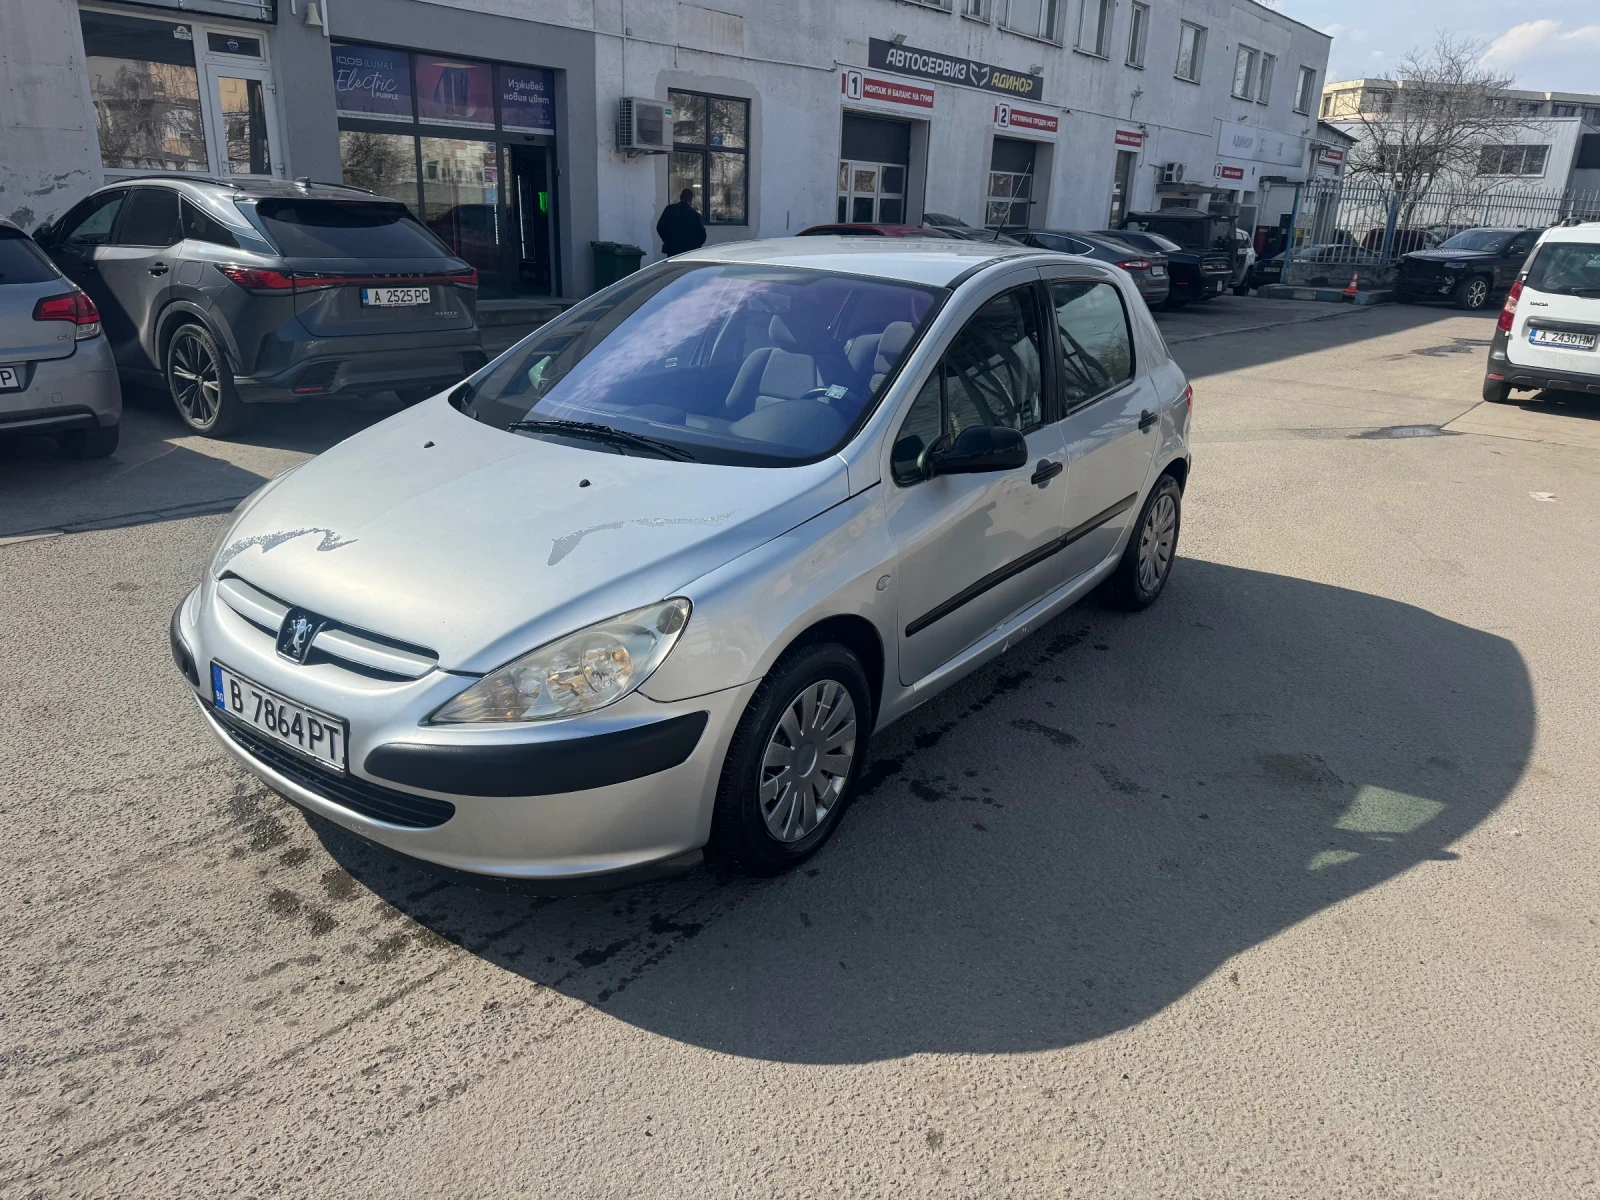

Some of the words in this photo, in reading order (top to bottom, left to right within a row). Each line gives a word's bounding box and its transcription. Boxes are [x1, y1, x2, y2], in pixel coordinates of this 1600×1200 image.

[335, 56, 362, 66] IQOS
[364, 60, 388, 69] ILUMA
[886, 48, 967, 80] АВТОСЕРВИЗ
[336, 68, 398, 98] Electric
[508, 79, 544, 91] Изживей
[851, 76, 858, 95] 1
[376, 92, 399, 100] PURPLE
[503, 92, 528, 102] новия
[528, 94, 550, 104] цвят
[864, 84, 887, 95] МОНТАЖ
[892, 89, 912, 99] БАЛАНС
[1001, 108, 1007, 123] 2
[374, 290, 382, 303] A
[1540, 331, 1547, 341] A
[230, 678, 243, 714] B
